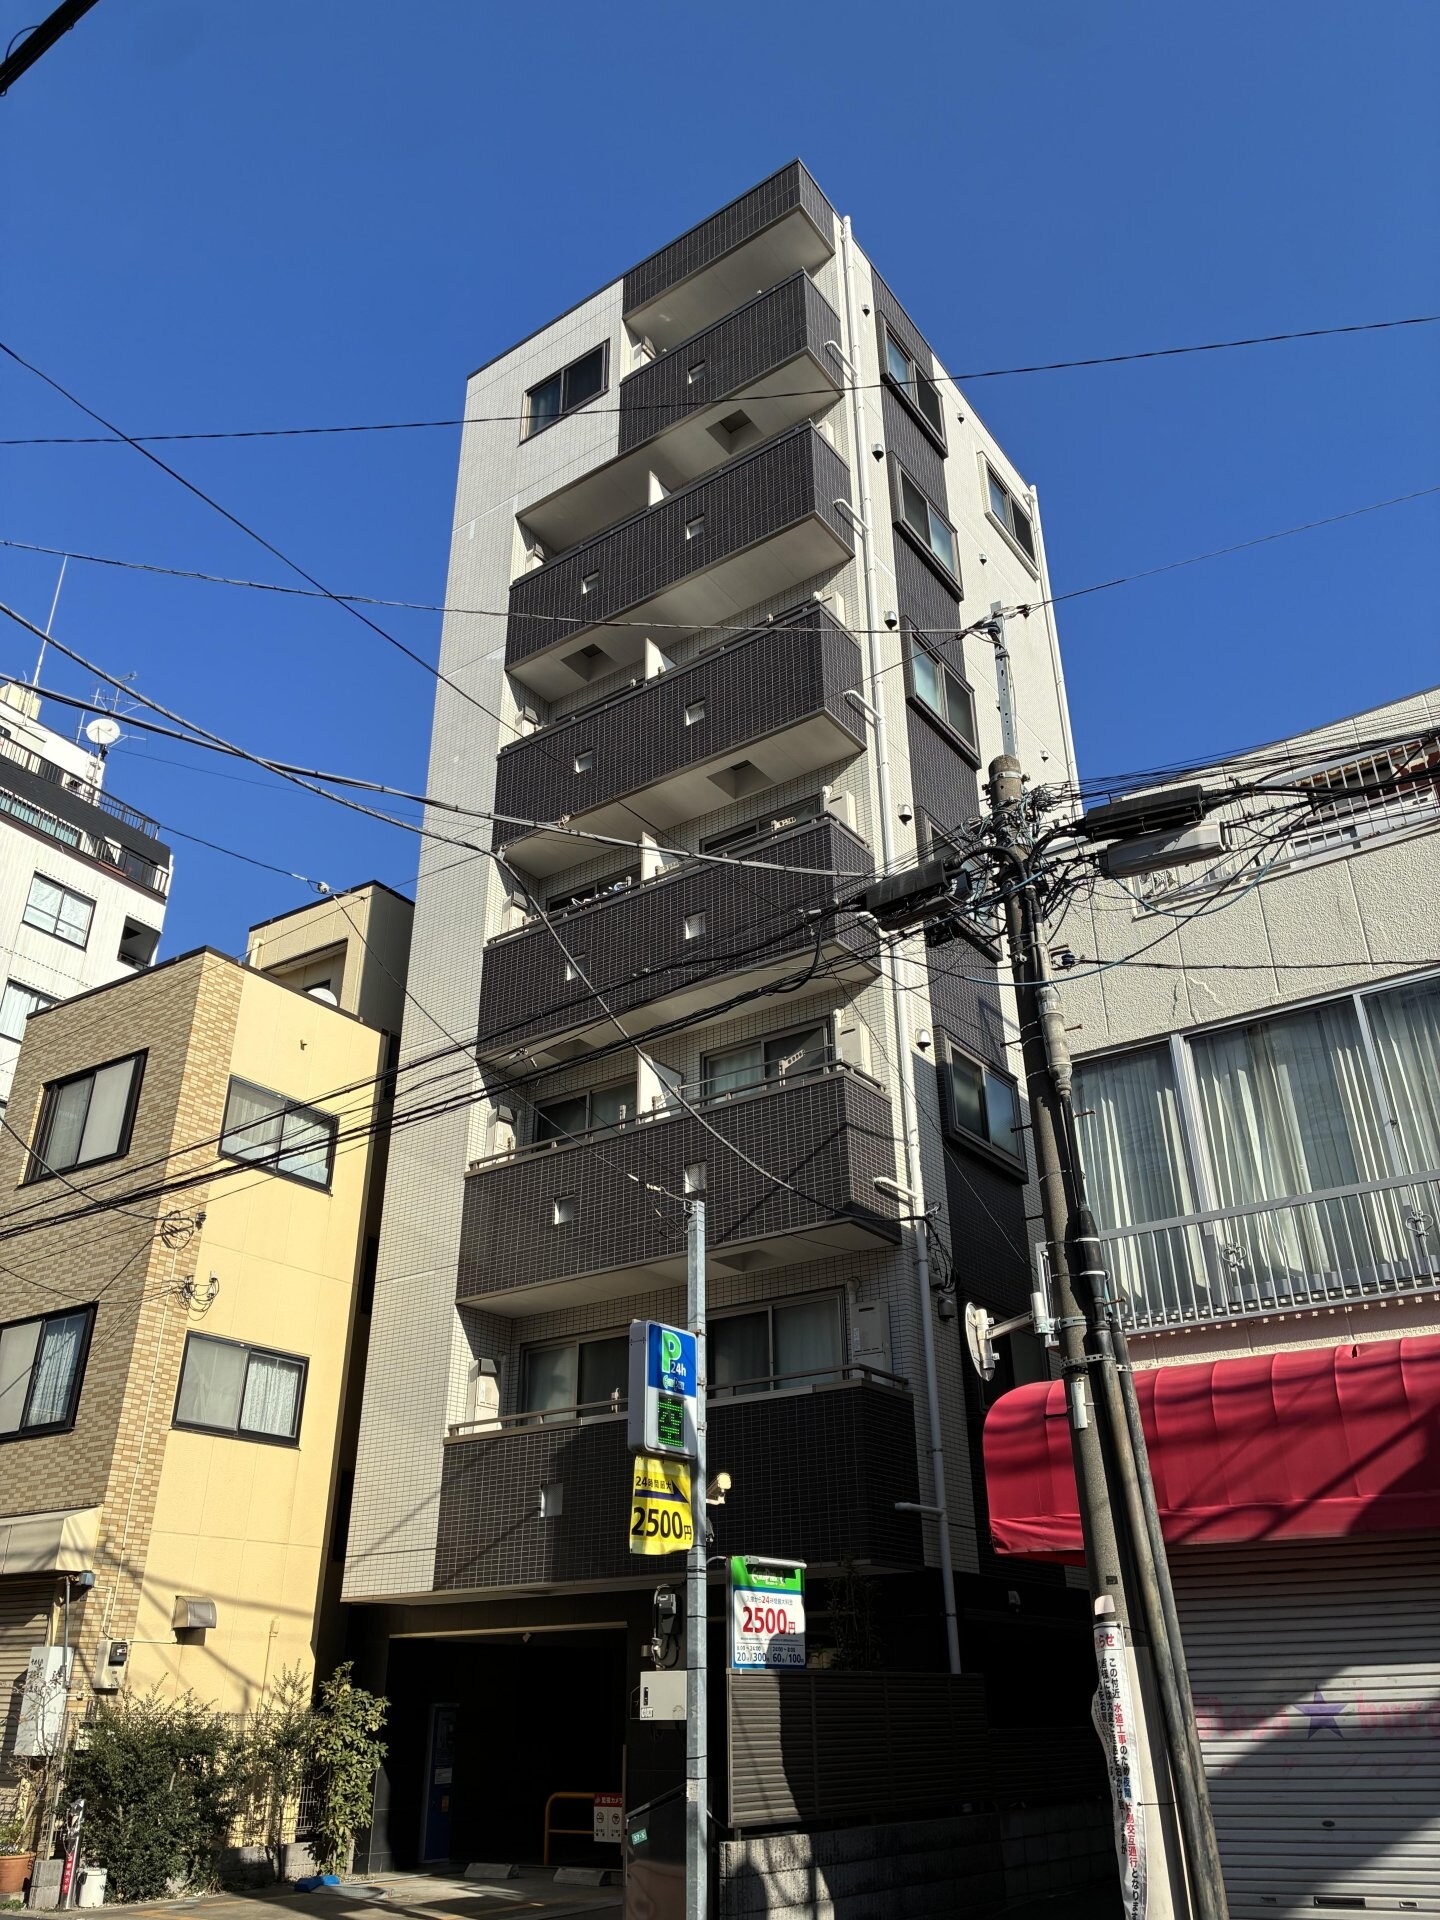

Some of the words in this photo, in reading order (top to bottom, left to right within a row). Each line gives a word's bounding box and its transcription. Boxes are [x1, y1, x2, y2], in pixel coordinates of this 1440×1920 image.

[662, 1329, 682, 1374] P
[671, 1361, 687, 1377] 24h
[635, 1476, 672, 1491] 24時間最大
[631, 1506, 692, 1540] 2500円
[742, 1606, 796, 1635] 2500円
